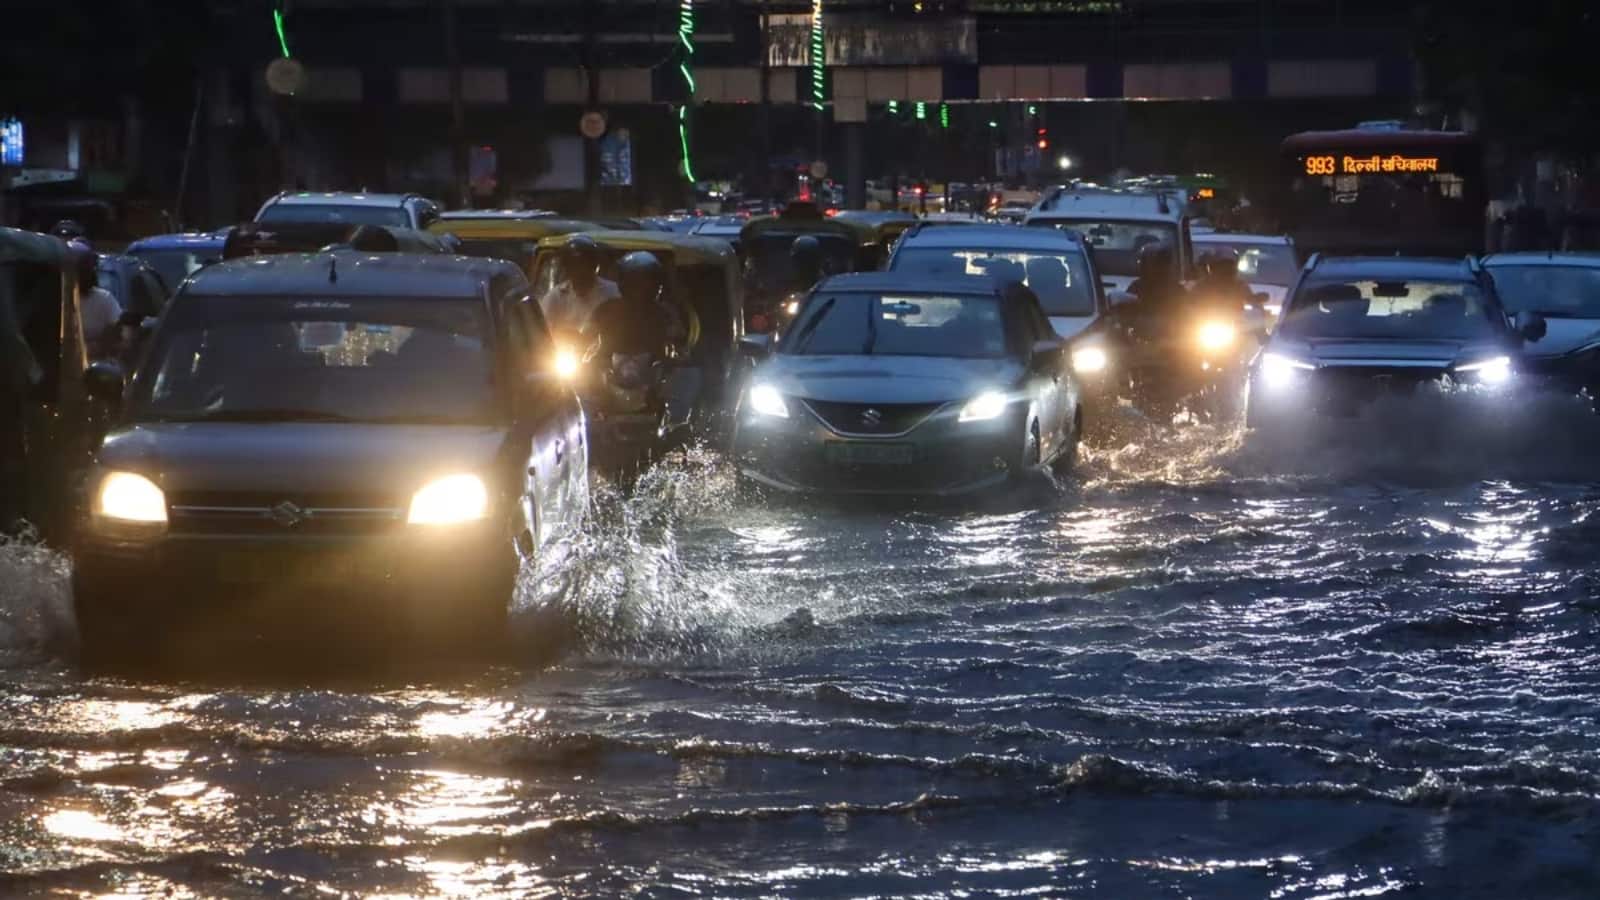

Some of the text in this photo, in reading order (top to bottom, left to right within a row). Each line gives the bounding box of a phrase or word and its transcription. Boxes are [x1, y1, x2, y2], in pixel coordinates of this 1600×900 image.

[1306, 155, 1438, 175] 993 दिल्ली सचिवालय
